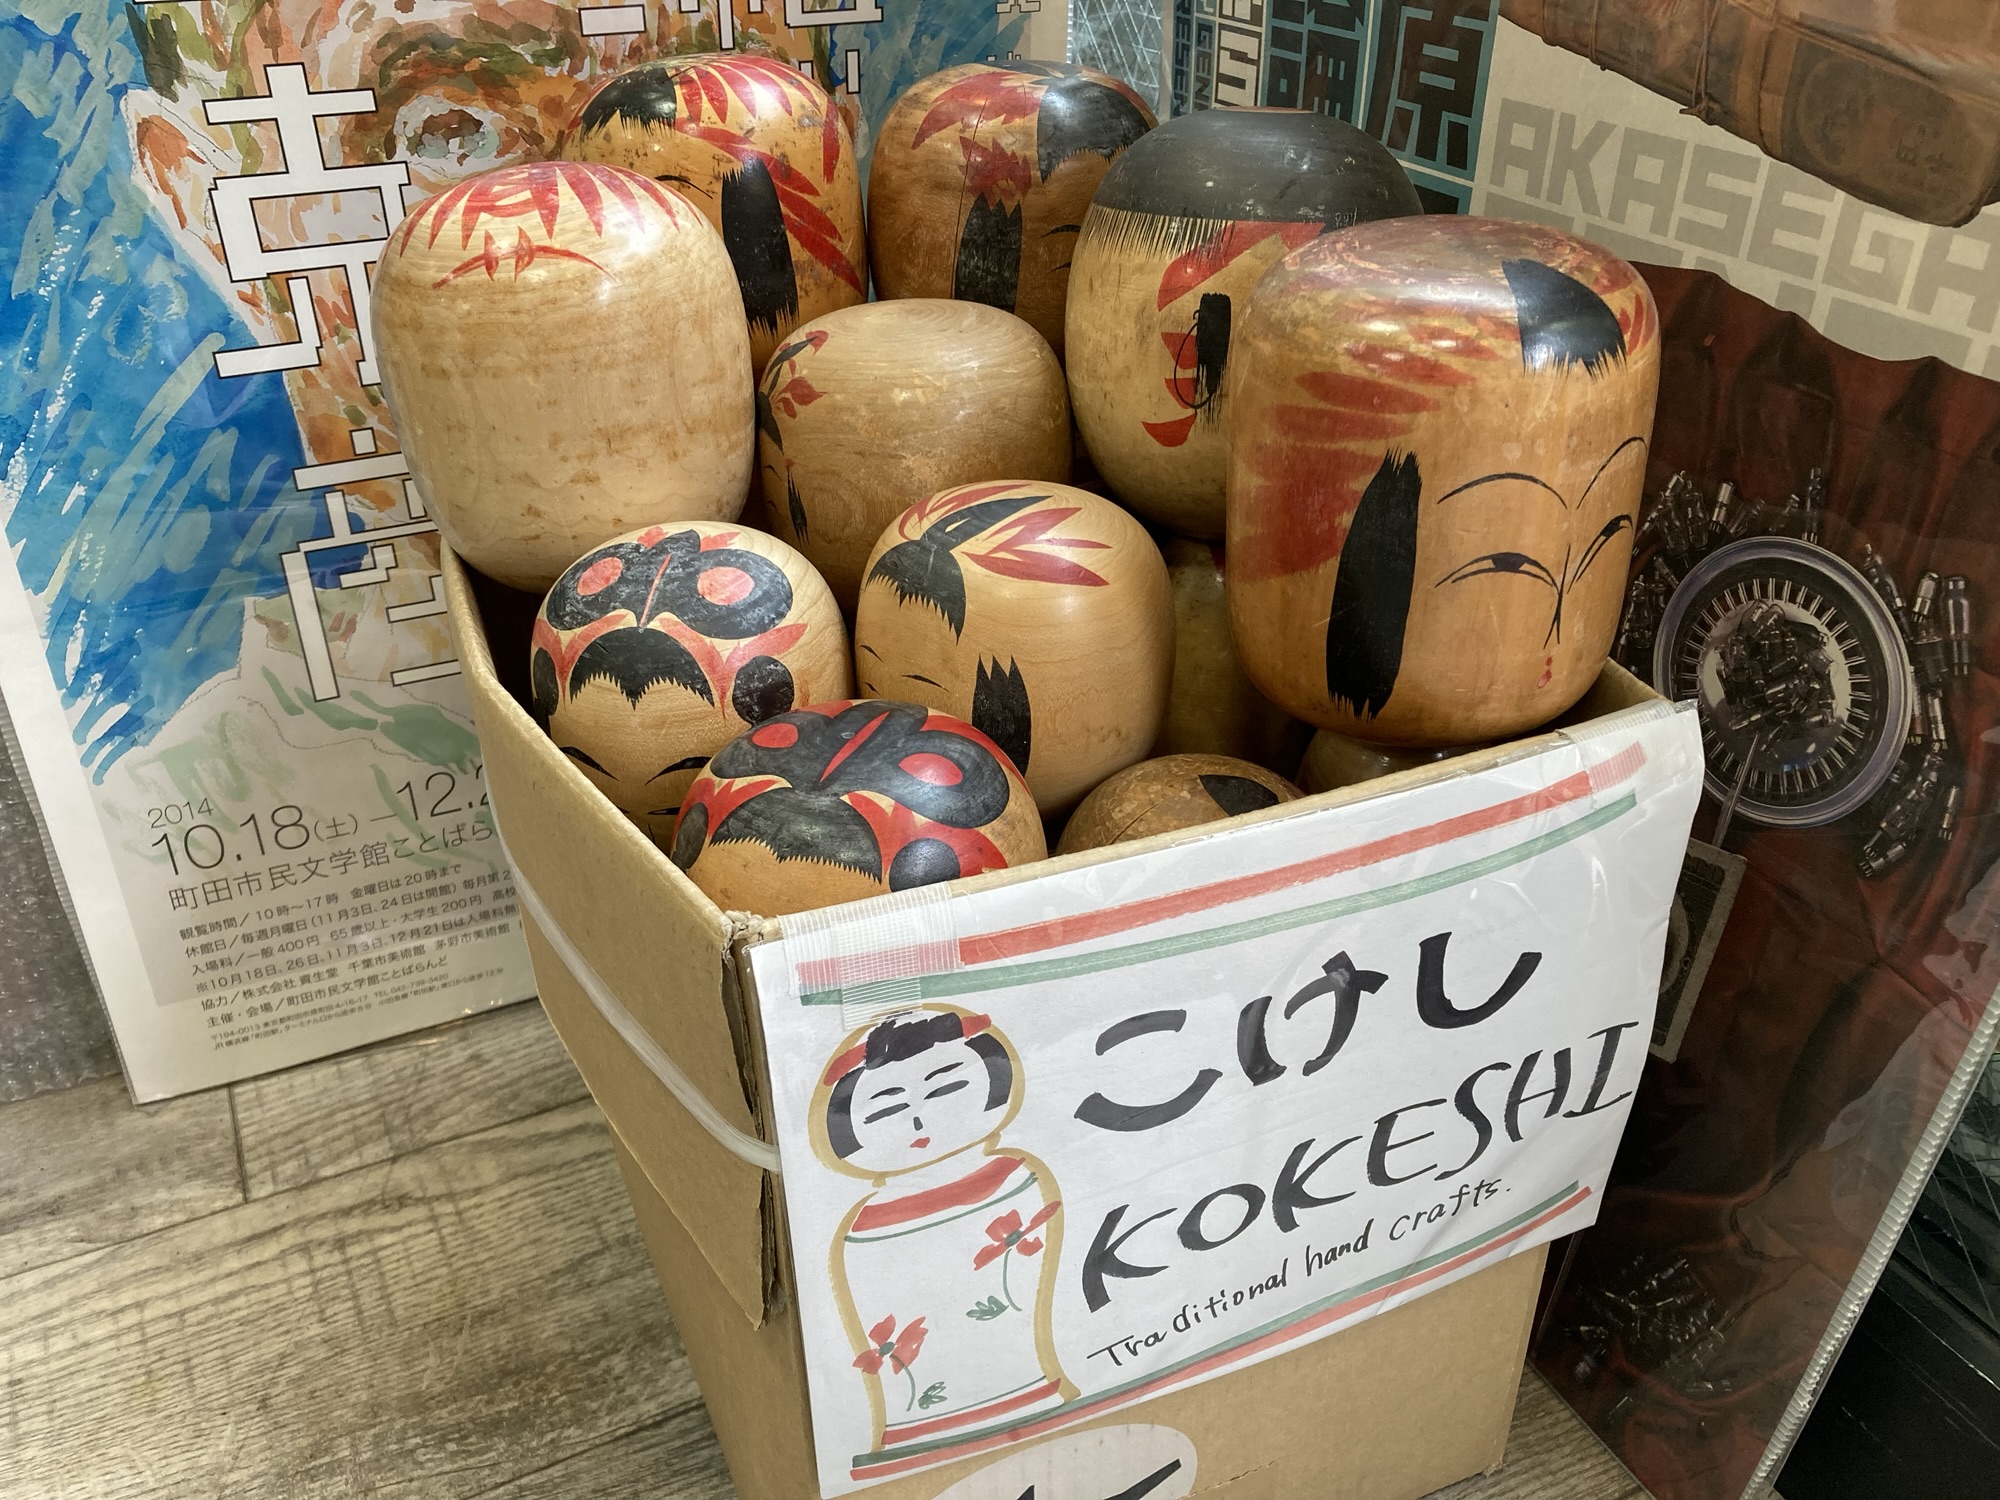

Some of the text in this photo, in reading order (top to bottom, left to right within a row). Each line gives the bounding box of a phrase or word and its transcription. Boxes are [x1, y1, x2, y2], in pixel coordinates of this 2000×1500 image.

[147, 797, 214, 829] 2014
[169, 820, 493, 915] 町田市民文学館ことばら
[1074, 932, 1542, 1132] こけし
[1082, 1021, 1639, 1313] KOKESHI
[1305, 1218, 1374, 1277] hand
